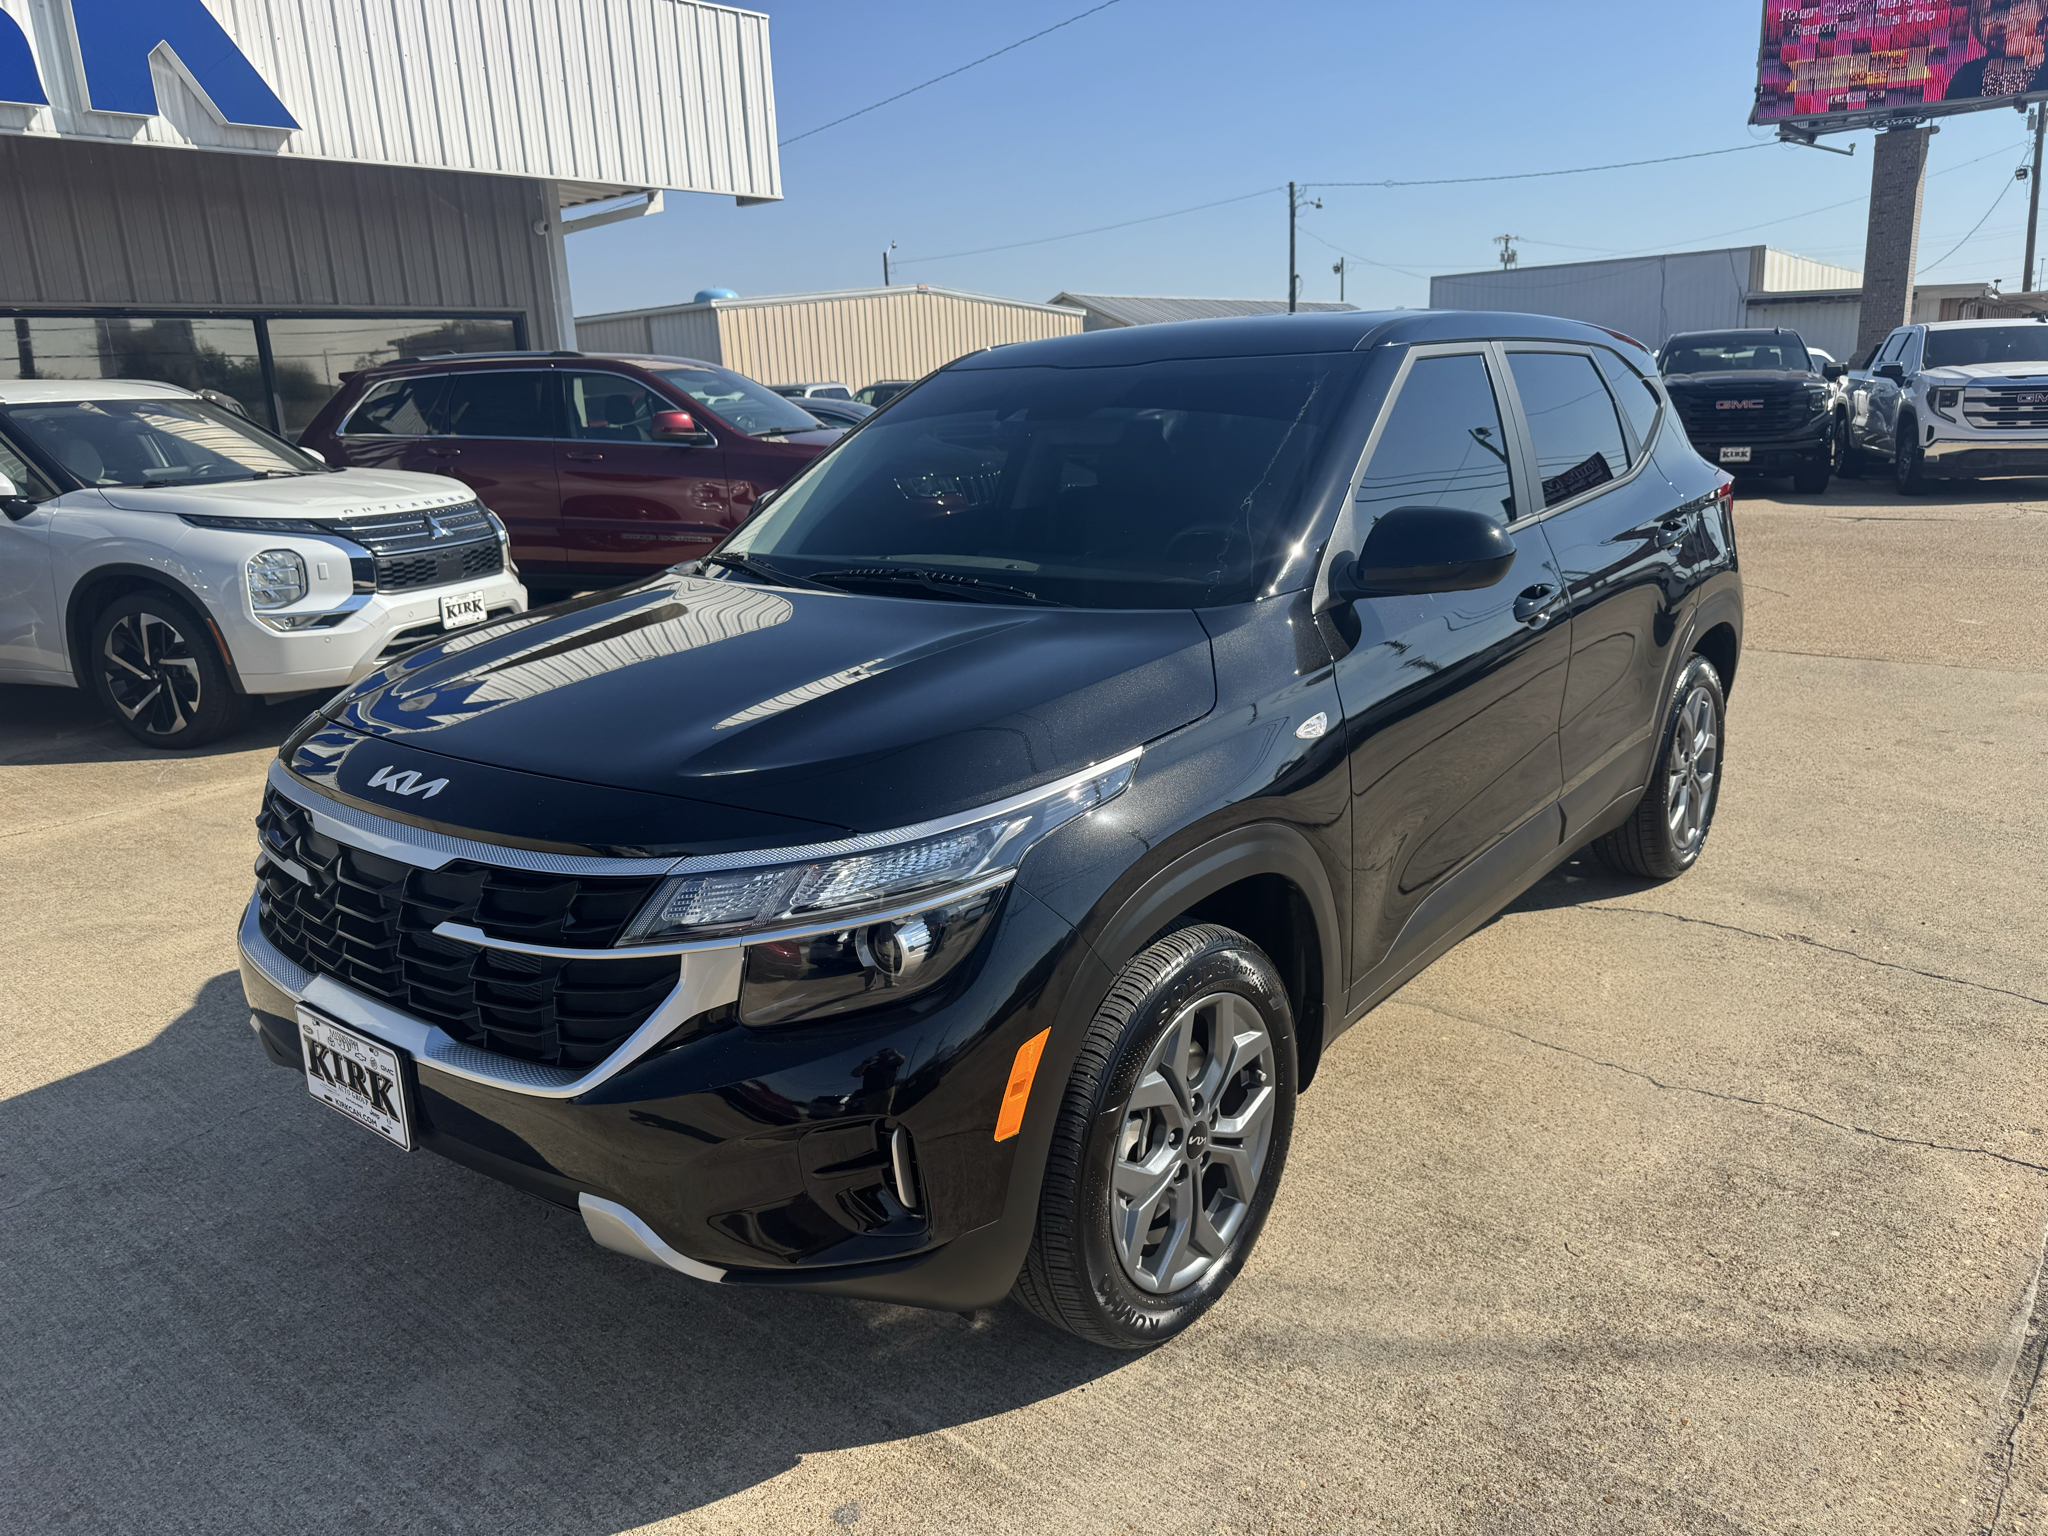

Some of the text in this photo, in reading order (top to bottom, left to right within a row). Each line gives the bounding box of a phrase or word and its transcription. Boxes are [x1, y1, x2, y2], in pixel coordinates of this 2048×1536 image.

[1779, 6, 1819, 22] Your
[1790, 9, 1936, 37] Reading This Too
[1872, 115, 1923, 127] LAMAR
[1715, 399, 1764, 410] GMC
[1722, 450, 1749, 459] KIRK
[343, 495, 466, 515] OUTLANDER
[445, 598, 483, 620] KIRK
[367, 765, 450, 799] KIA
[302, 1033, 401, 1123] KIRK
